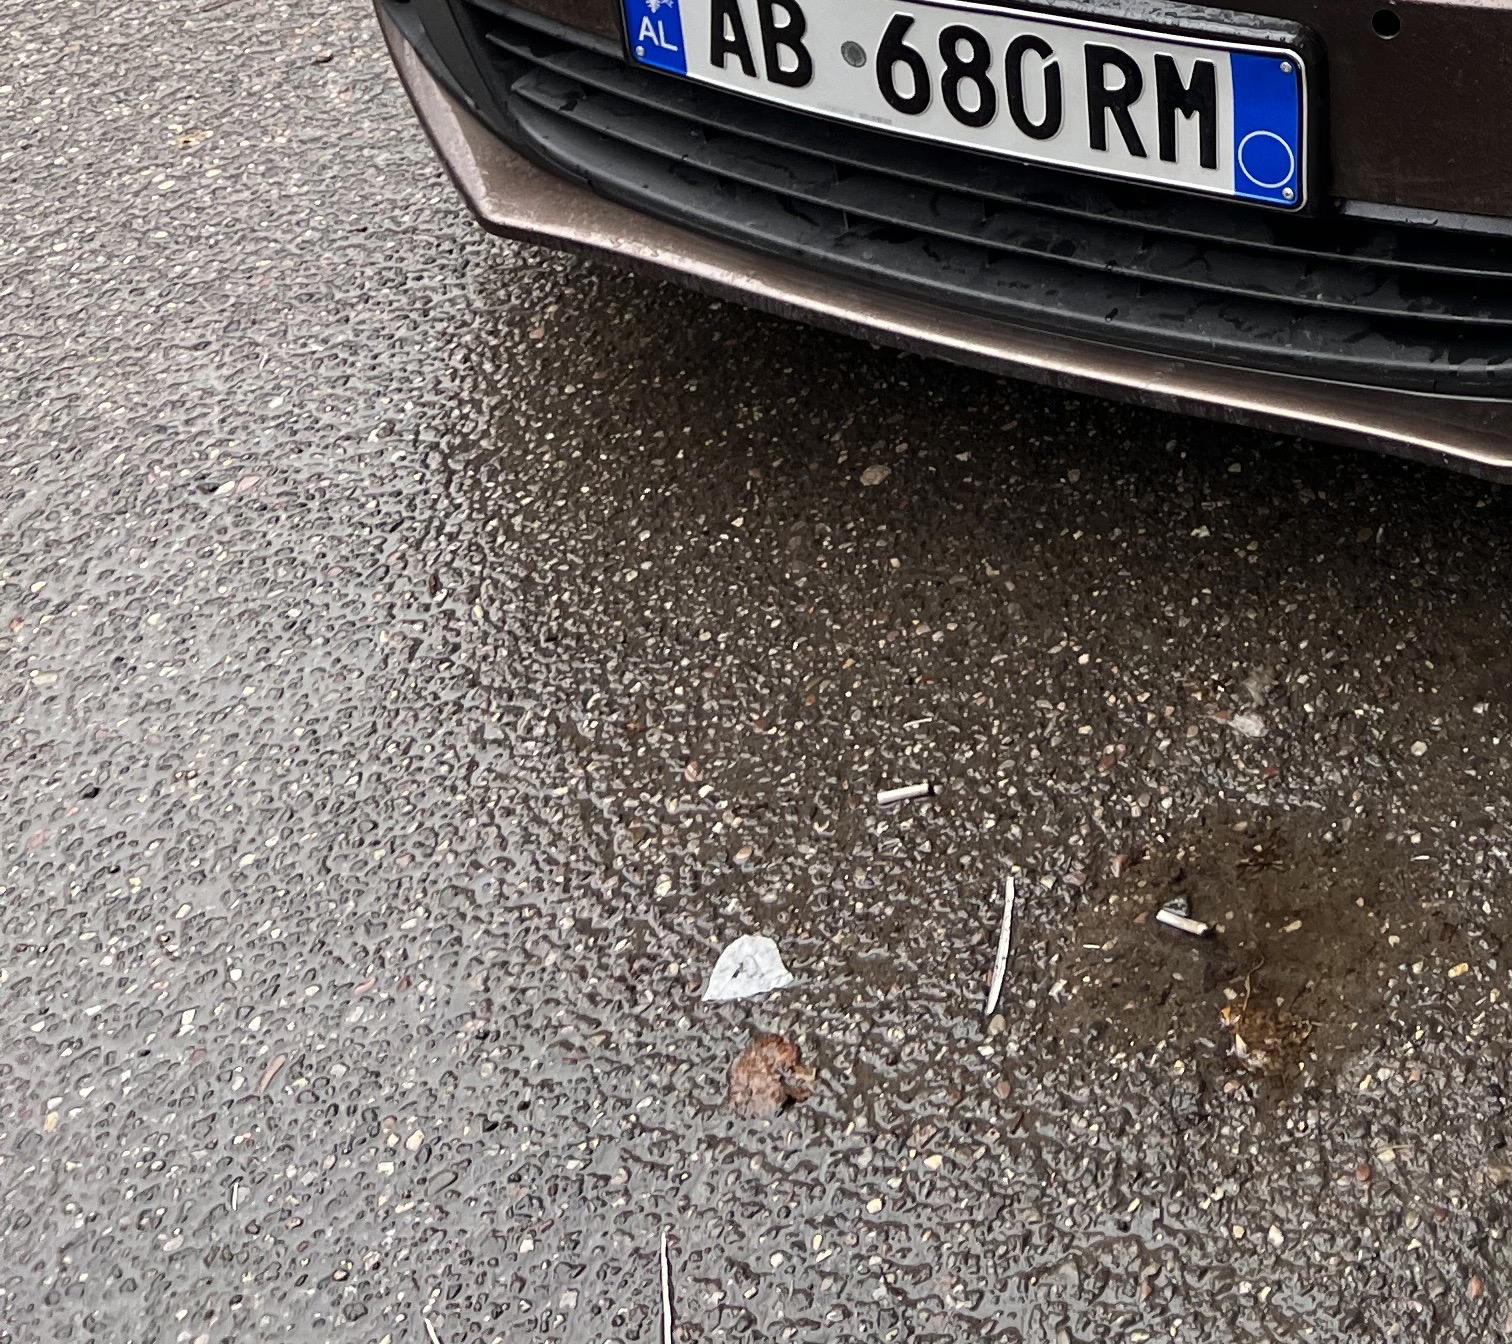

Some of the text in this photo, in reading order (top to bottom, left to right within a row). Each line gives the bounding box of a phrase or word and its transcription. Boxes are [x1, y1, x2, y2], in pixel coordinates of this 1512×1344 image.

[637, 15, 678, 52] AL
[875, 13, 1062, 141] 680
[1083, 43, 1217, 170] RM
